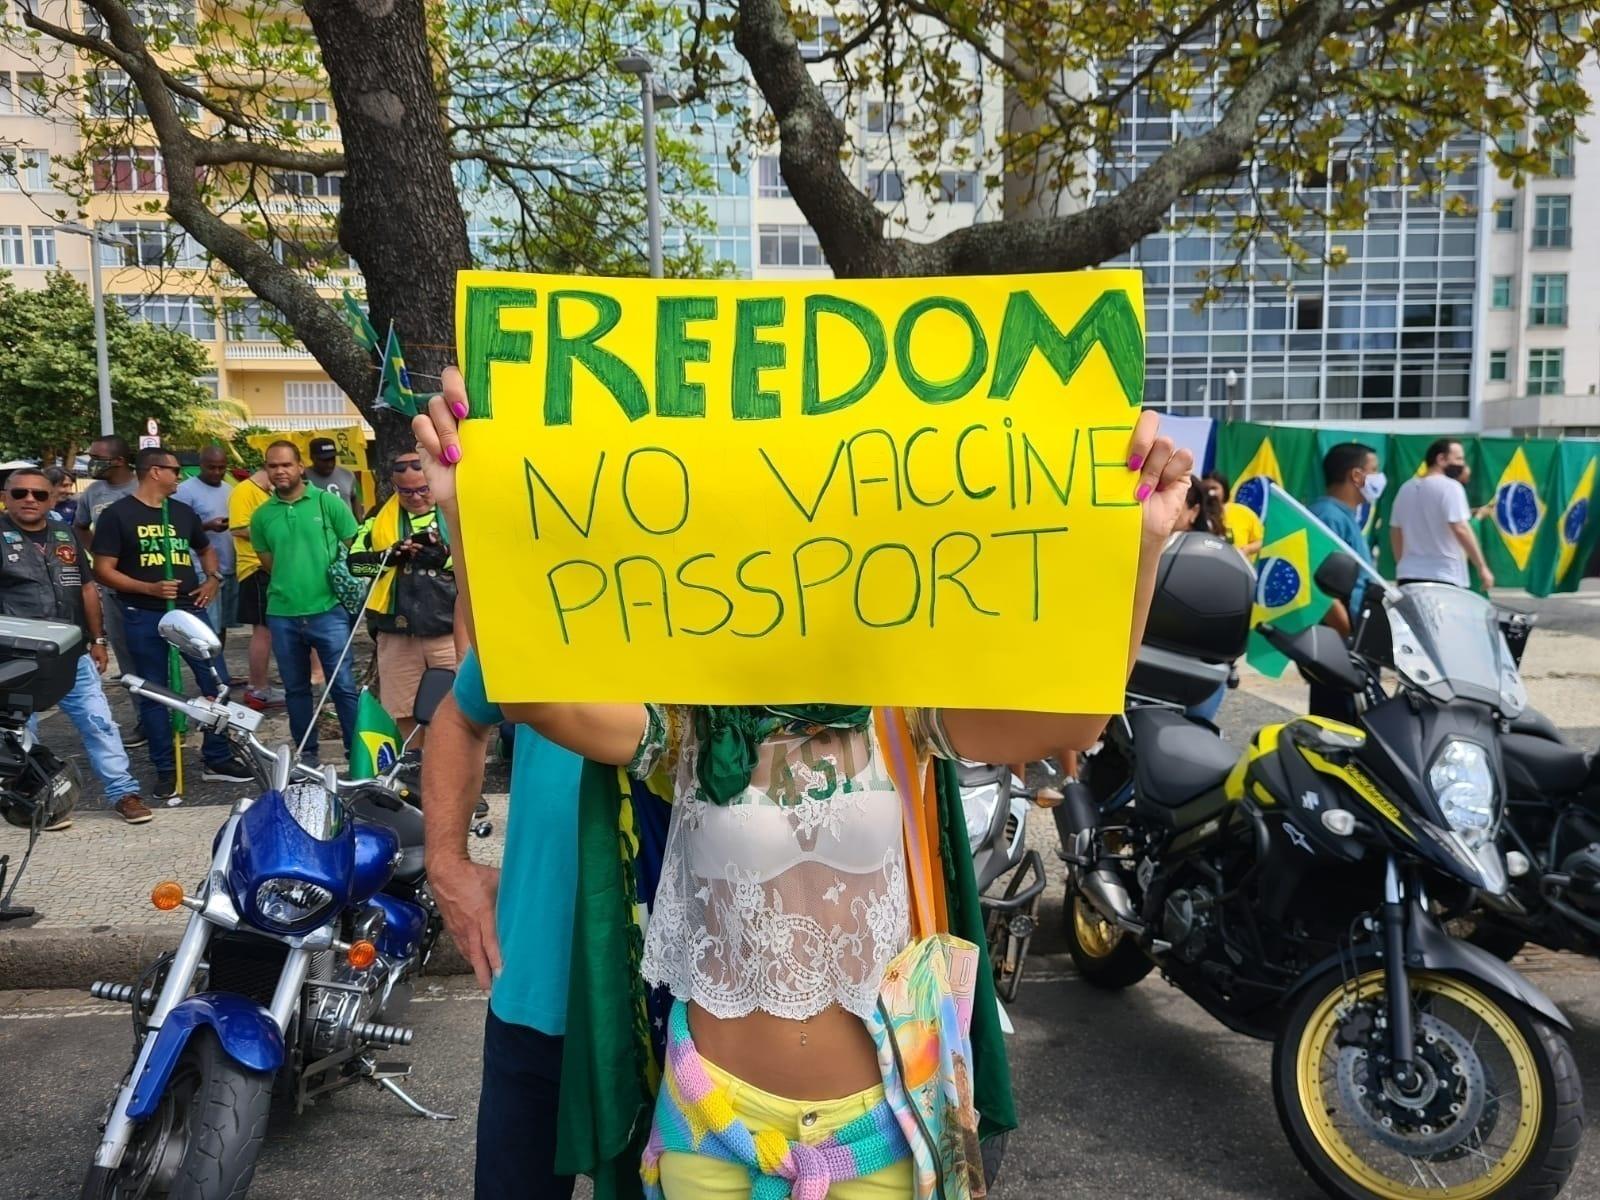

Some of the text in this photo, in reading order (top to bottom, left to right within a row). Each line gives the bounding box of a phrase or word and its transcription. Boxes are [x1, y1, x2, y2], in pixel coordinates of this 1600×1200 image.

[464, 286, 1145, 427] FREEDOM
[137, 524, 177, 538] DEUS
[524, 446, 690, 540] NO
[547, 526, 1069, 645] PASSPORT
